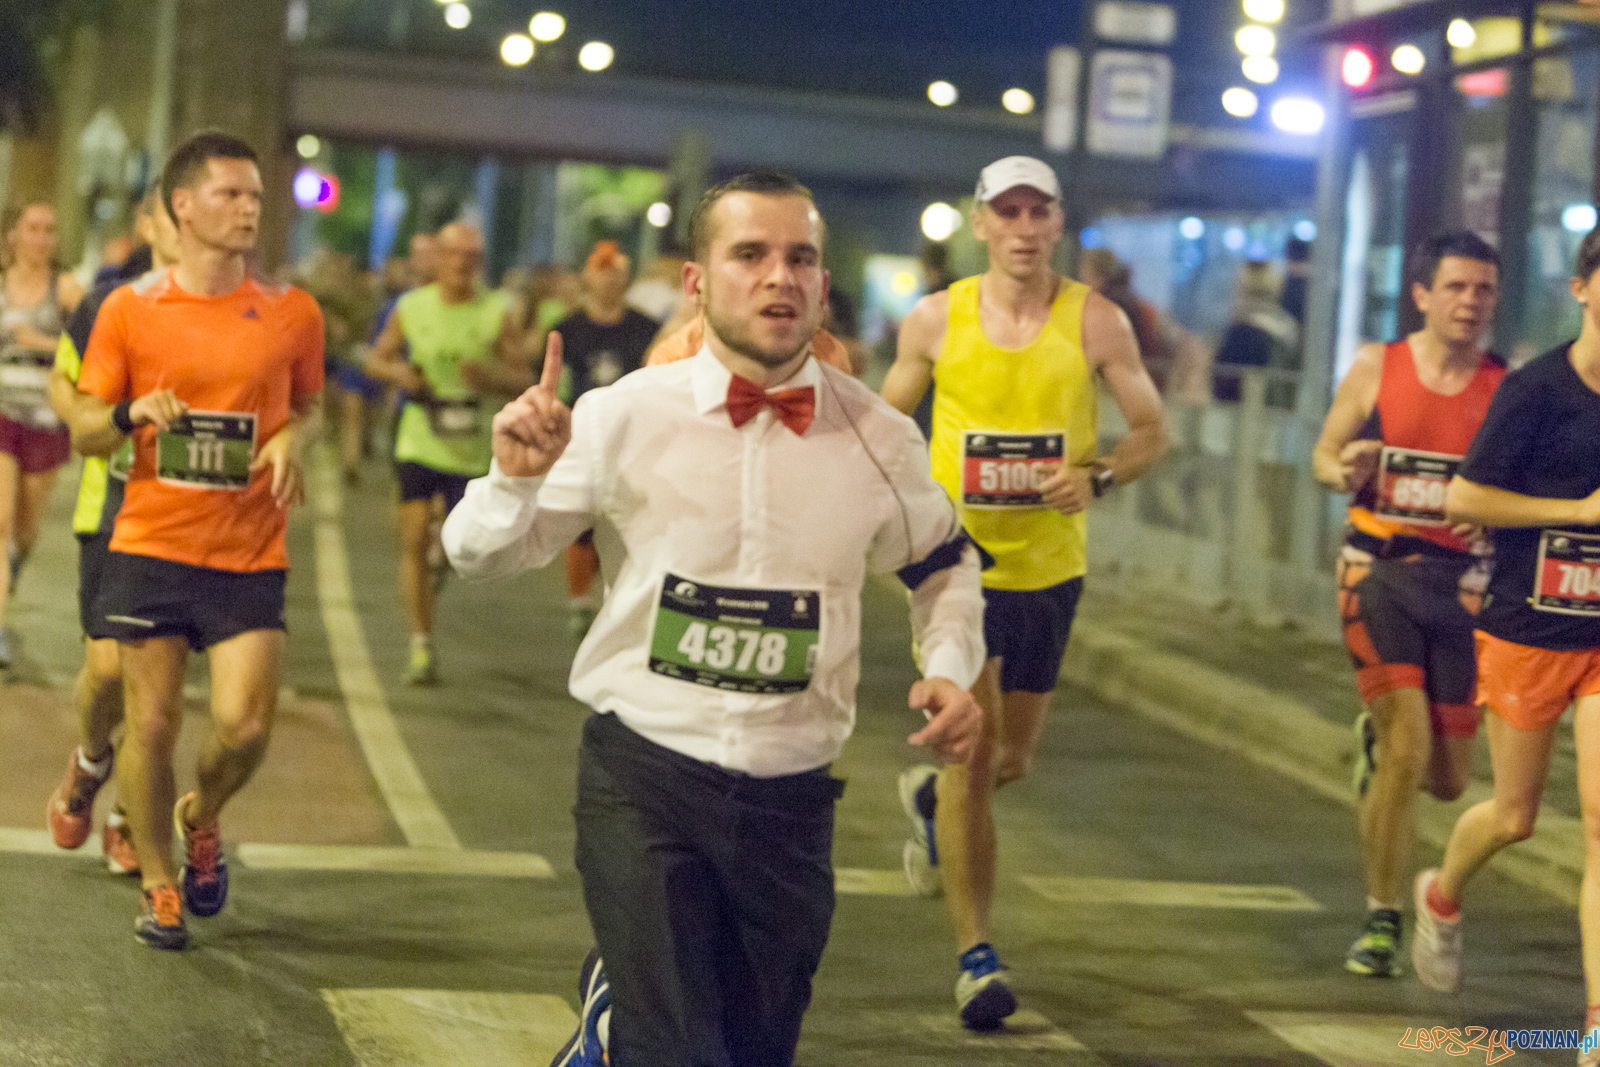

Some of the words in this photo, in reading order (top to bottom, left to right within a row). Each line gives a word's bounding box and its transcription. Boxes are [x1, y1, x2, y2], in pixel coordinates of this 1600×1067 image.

[186, 440, 224, 471] 111
[1394, 477, 1445, 508] 650
[677, 621, 788, 676] 4378
